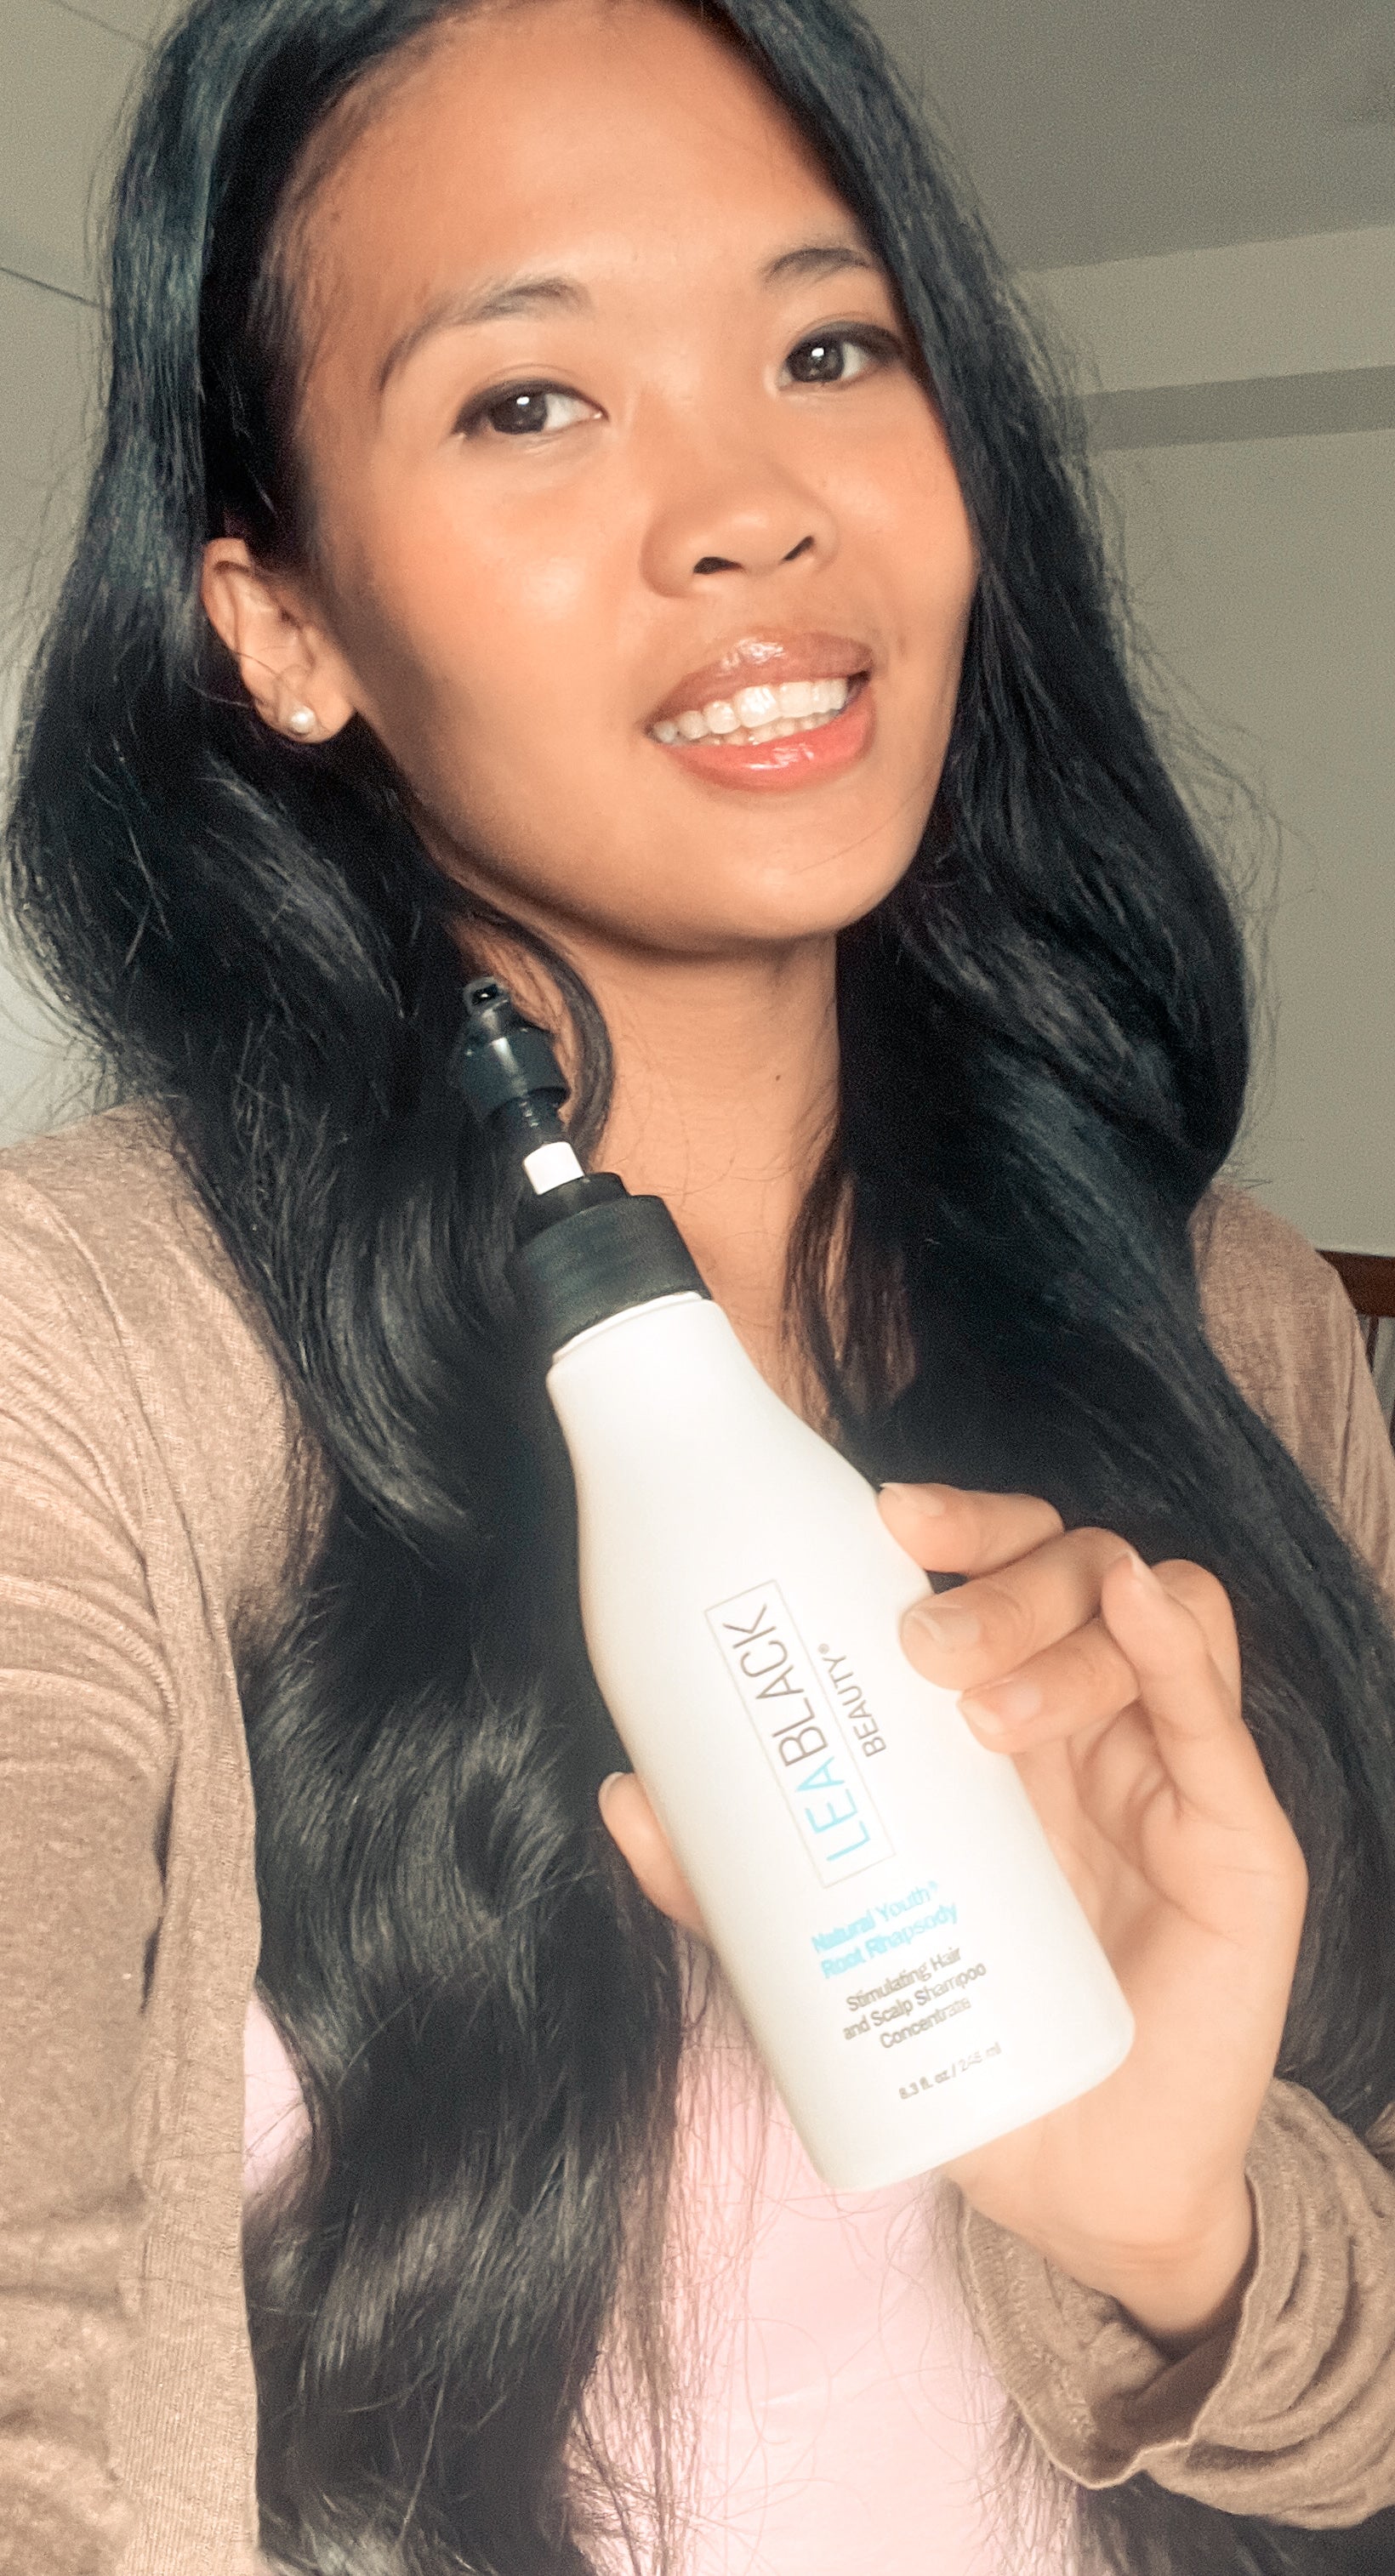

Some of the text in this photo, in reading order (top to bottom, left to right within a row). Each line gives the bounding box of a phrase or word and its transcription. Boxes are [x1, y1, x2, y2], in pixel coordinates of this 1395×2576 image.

[811, 1909, 876, 1953] Natural
[820, 1902, 958, 1980] Root Rhapsody
[842, 1963, 988, 2040] and Scalp Shampoo
[846, 1947, 961, 2012] Stimulating Hair
[879, 1998, 972, 2049] Concentrate
